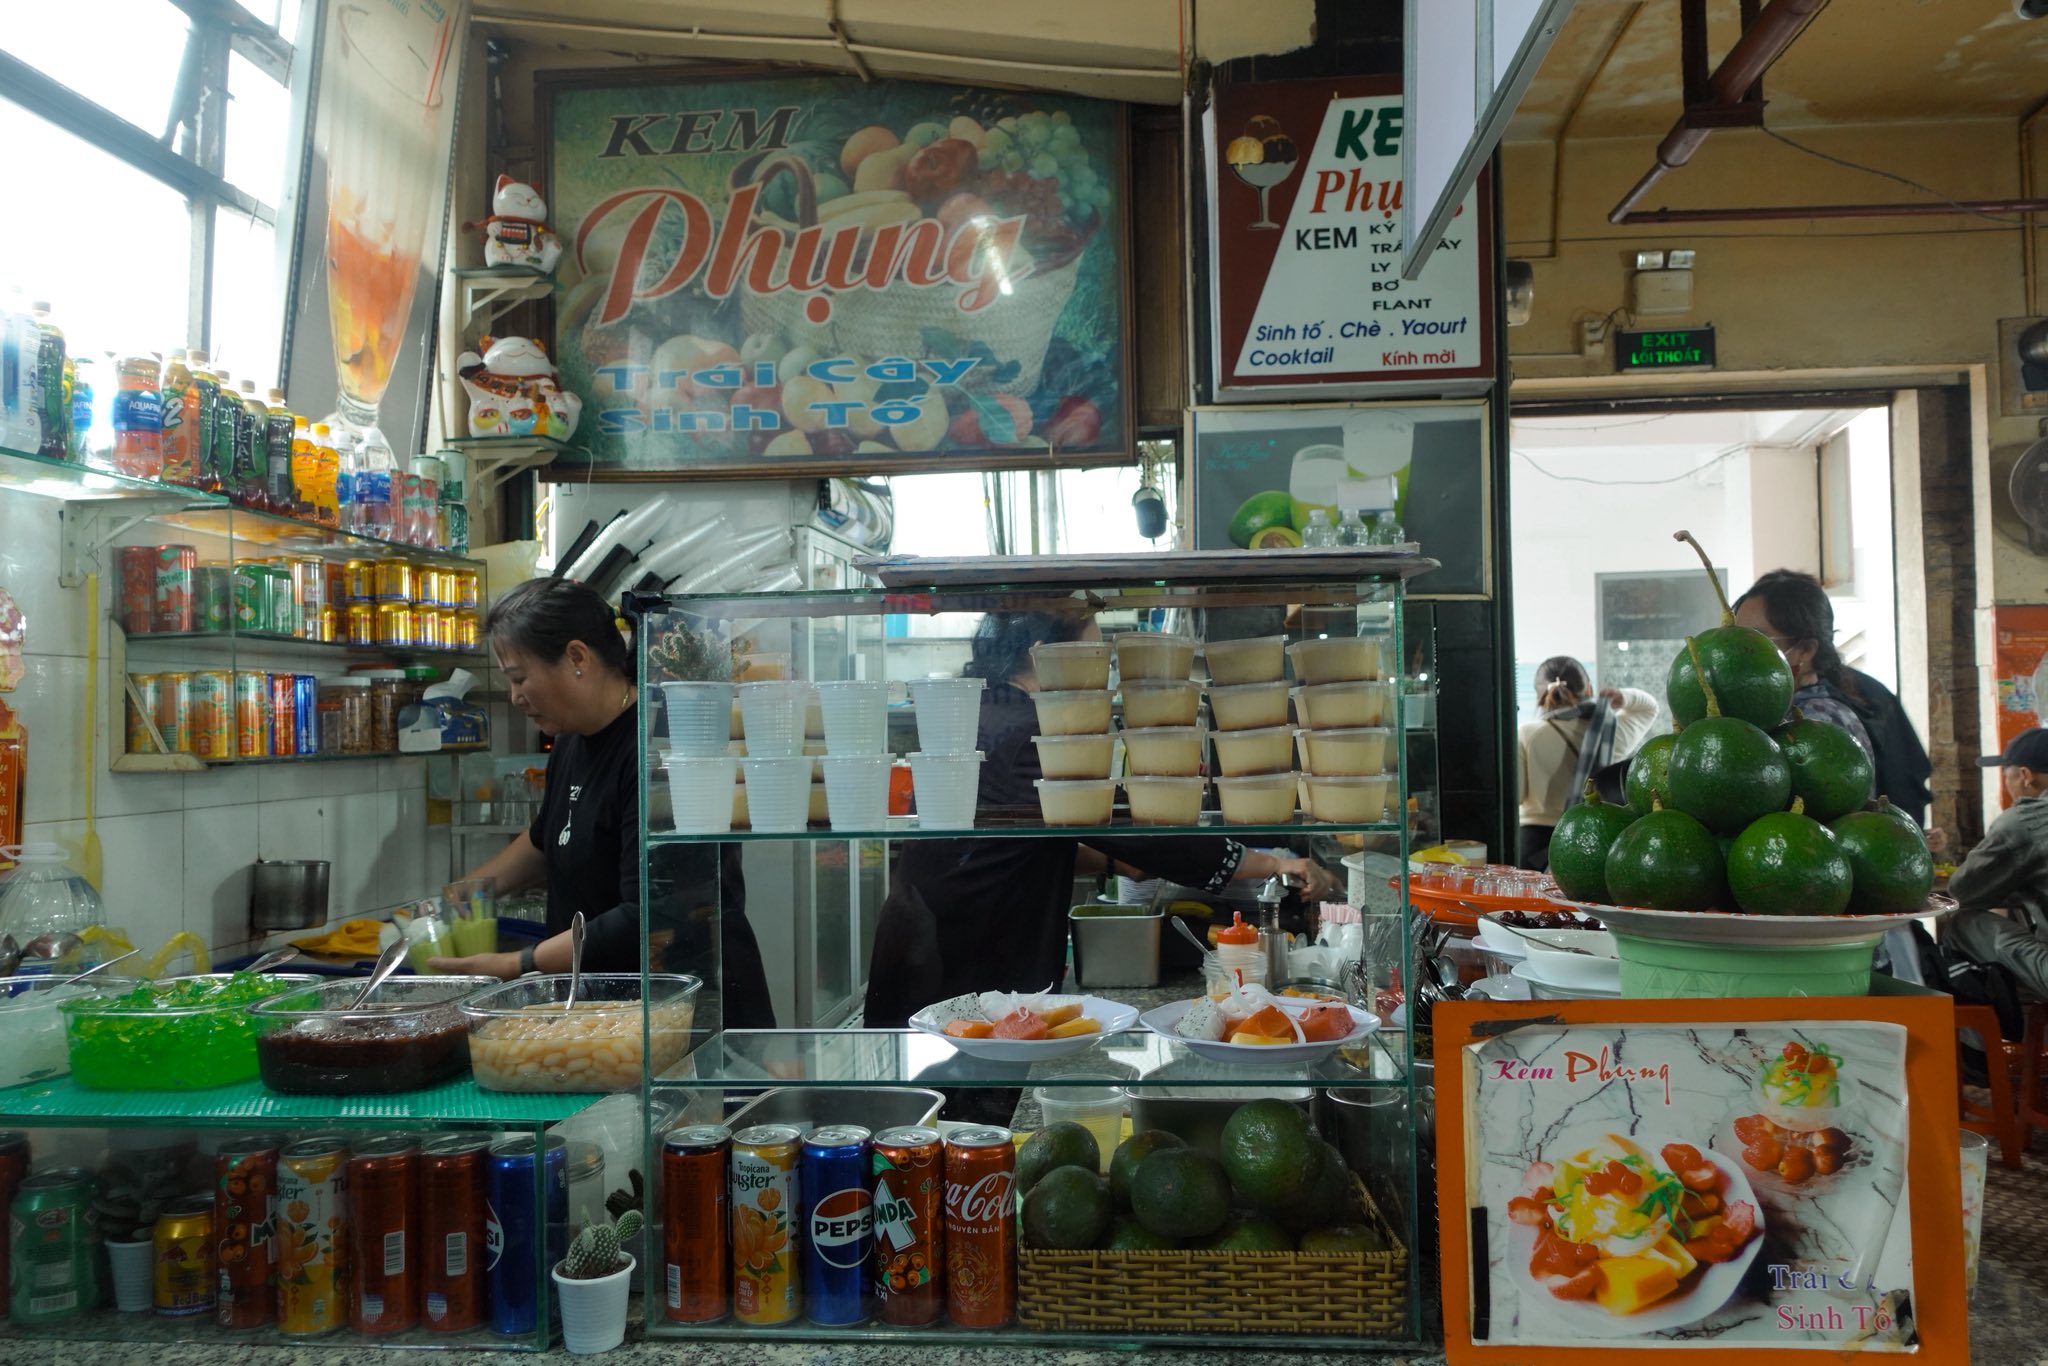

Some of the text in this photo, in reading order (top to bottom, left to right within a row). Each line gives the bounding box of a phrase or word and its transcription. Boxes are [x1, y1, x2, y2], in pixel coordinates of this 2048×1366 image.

[599, 107, 799, 158] KEM
[1334, 107, 1403, 161] KE
[1296, 226, 1358, 251] KEM
[576, 178, 1035, 326] Phụng
[1371, 262, 1391, 272] LY
[1373, 298, 1432, 310] FLANT
[1256, 324, 1295, 341] Sinh
[1340, 321, 1381, 339] Chè
[1401, 316, 1467, 336] Yaourt
[1641, 331, 1690, 348] EXIT
[1249, 347, 1334, 366] Cooktail
[1382, 351, 1418, 366] Kính
[599, 357, 983, 391] Trái Cây
[599, 395, 926, 434] Sinh Tố
[1488, 1045, 1671, 1105] Kem Phụng
[738, 1161, 770, 1174] Tropicana
[815, 1213, 872, 1238] PEPS
[1768, 1264, 1830, 1291] Trái
[1777, 1305, 1844, 1330] Sinh
